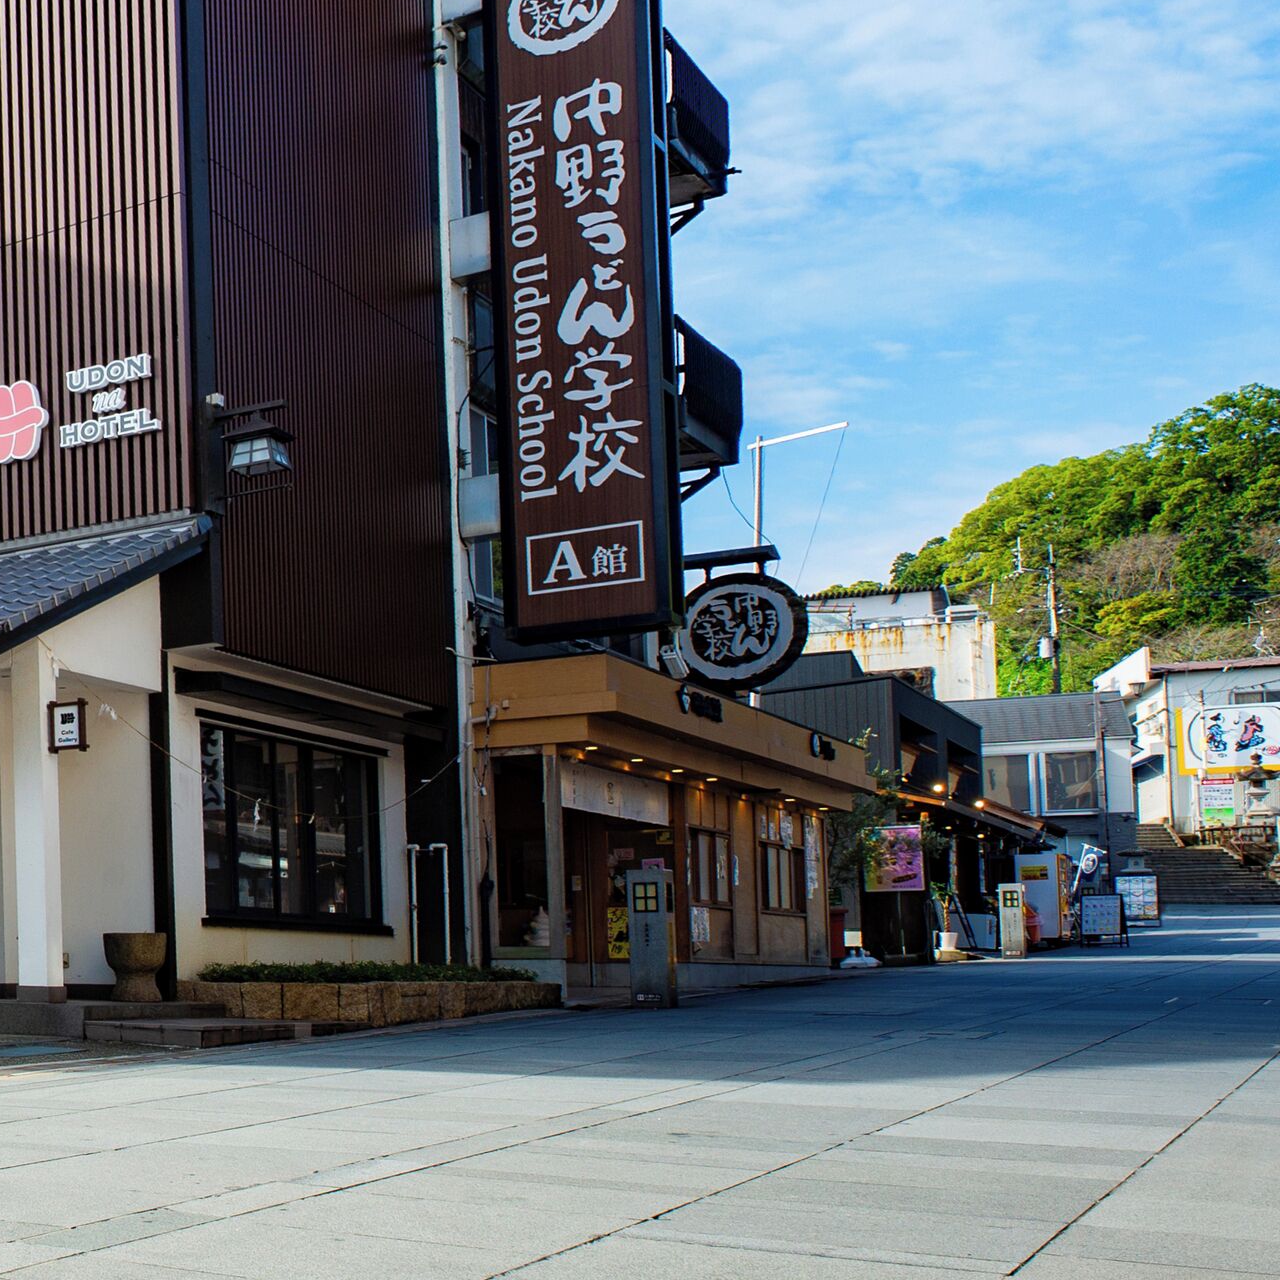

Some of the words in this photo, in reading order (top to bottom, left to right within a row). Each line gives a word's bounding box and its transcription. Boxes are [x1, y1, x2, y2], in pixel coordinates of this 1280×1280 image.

[507, 95, 546, 248] Nakano
[512, 253, 550, 363] Udon
[553, 78, 645, 492] 中野うどん学校
[60, 408, 161, 448] HOTEL
[66, 353, 152, 393] UDON
[92, 387, 126, 413] na
[517, 370, 557, 502] School
